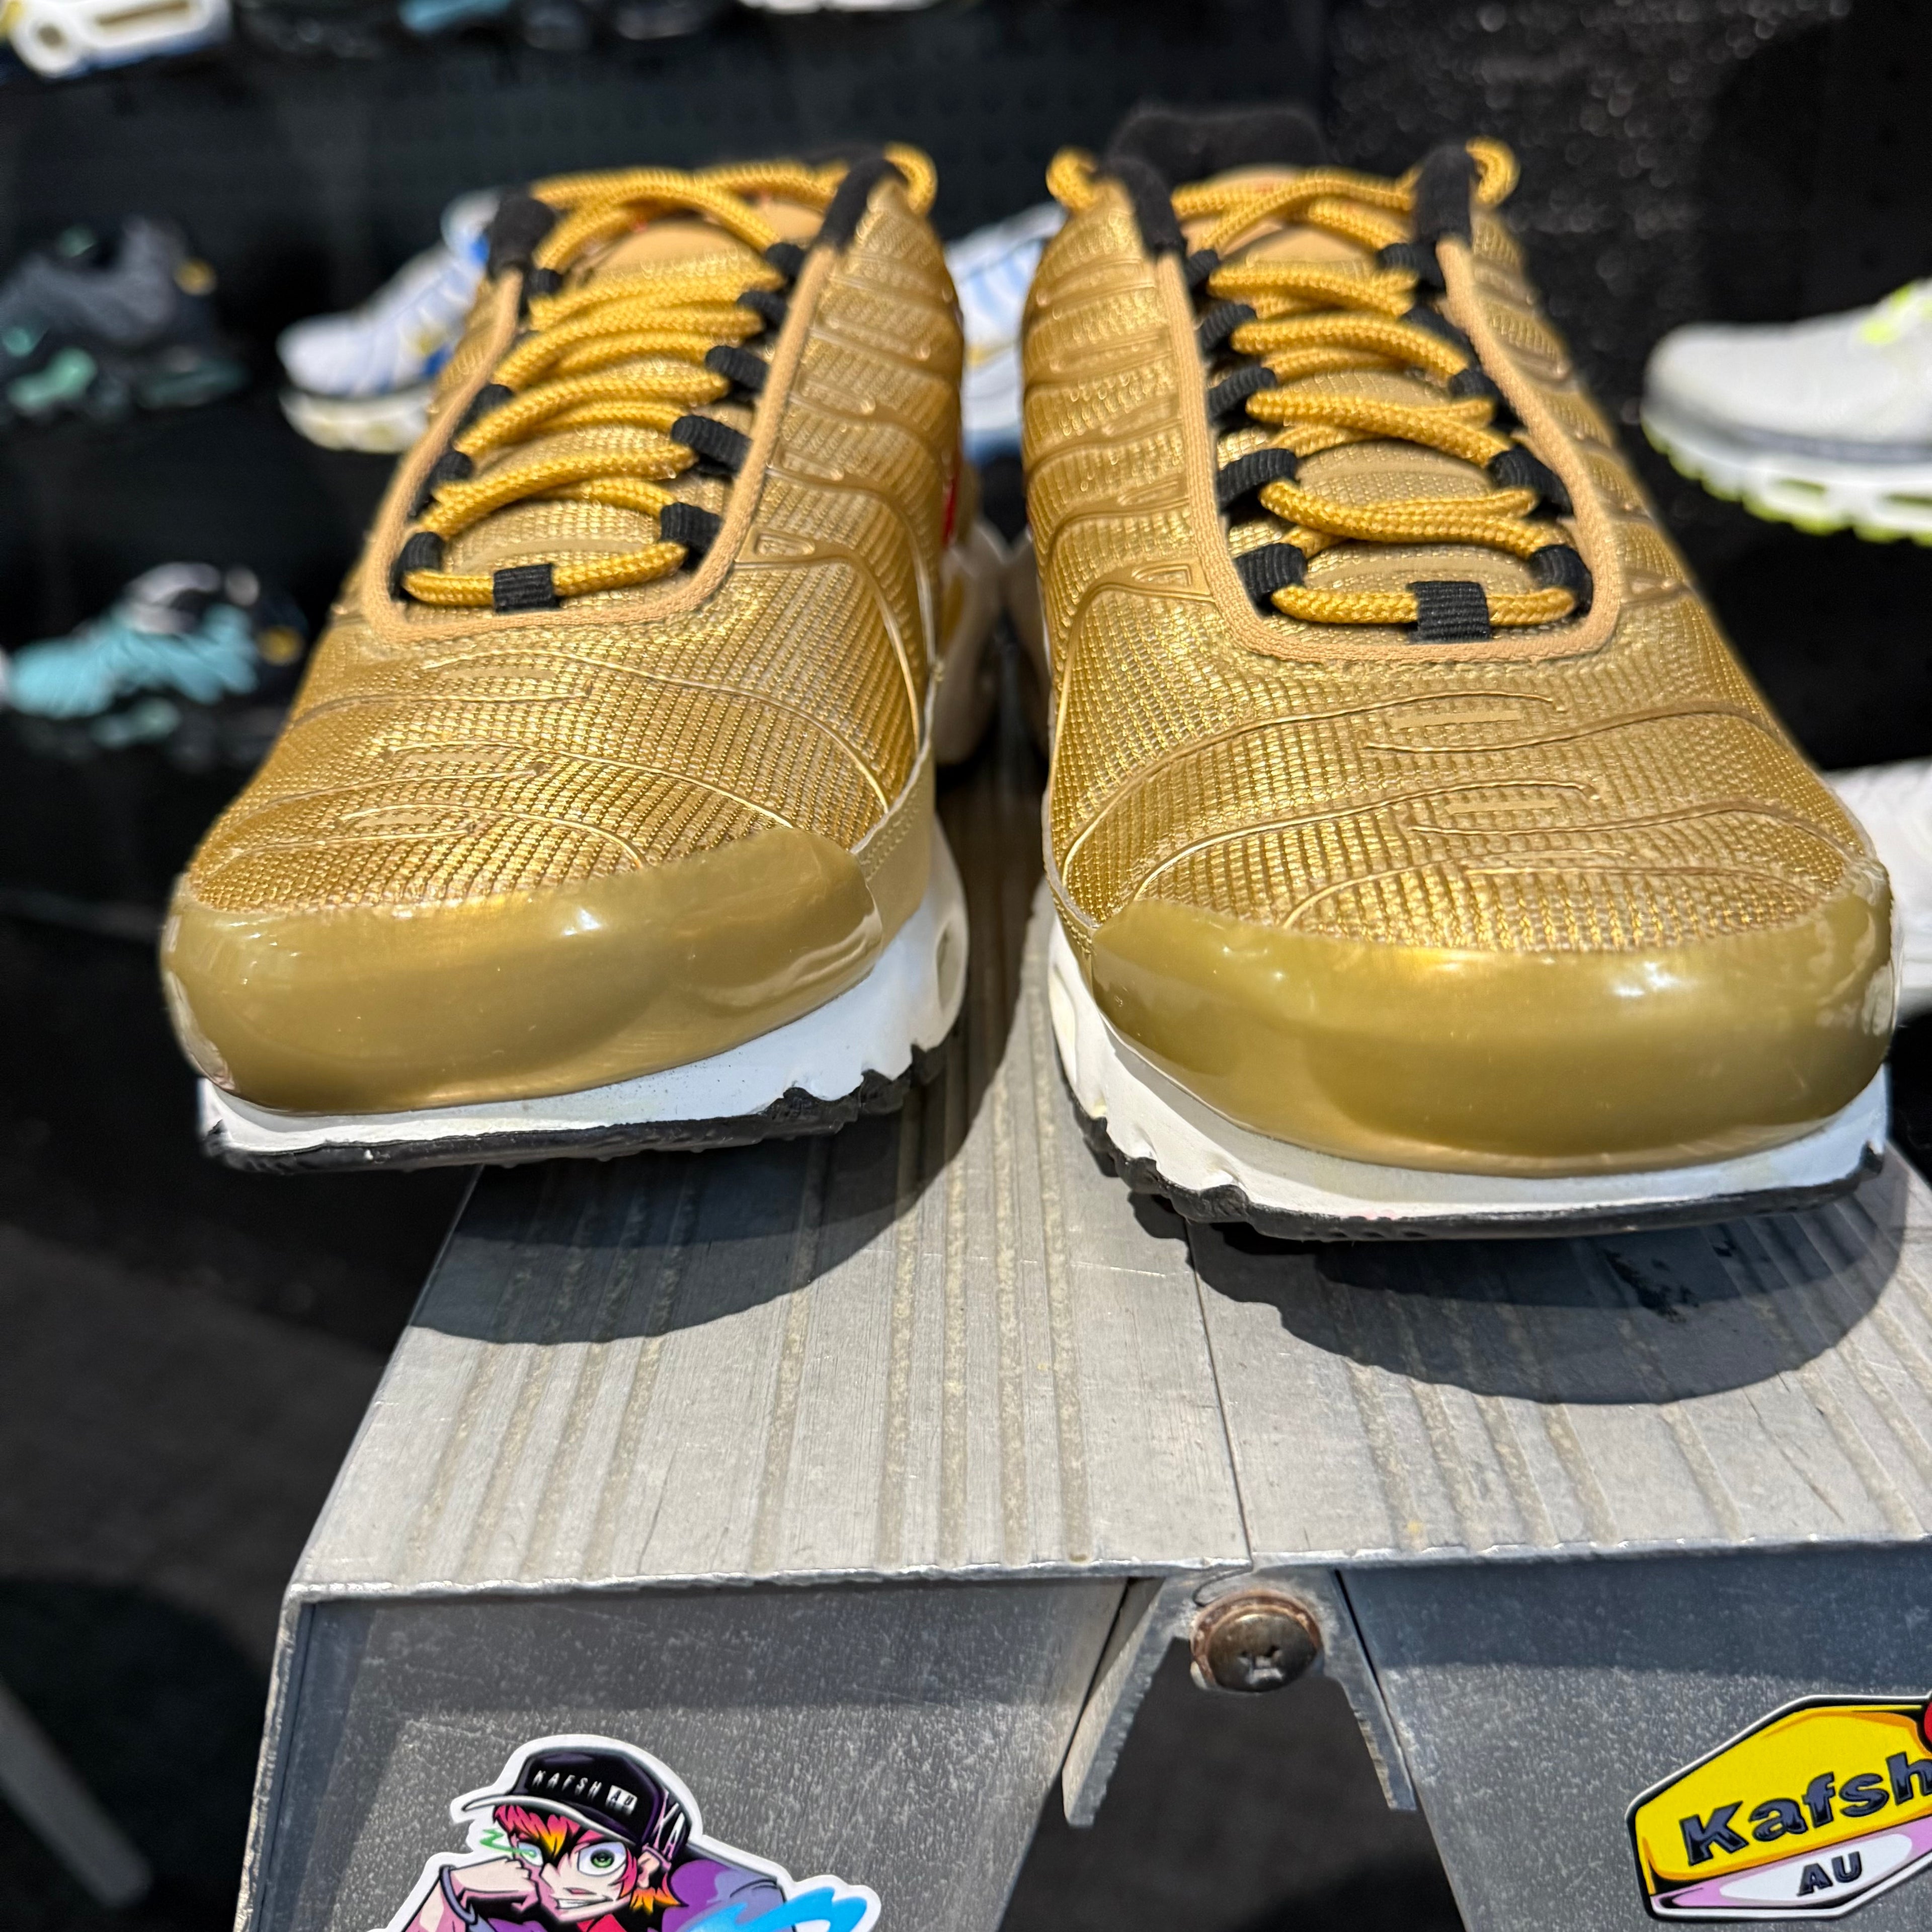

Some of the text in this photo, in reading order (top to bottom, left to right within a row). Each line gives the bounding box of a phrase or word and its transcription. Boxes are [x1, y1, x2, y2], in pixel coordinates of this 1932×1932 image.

[532, 1770, 635, 1810] KAFSH AU
[1679, 1751, 1932, 1866] Kafsh
[1797, 1851, 1862, 1896] AU
